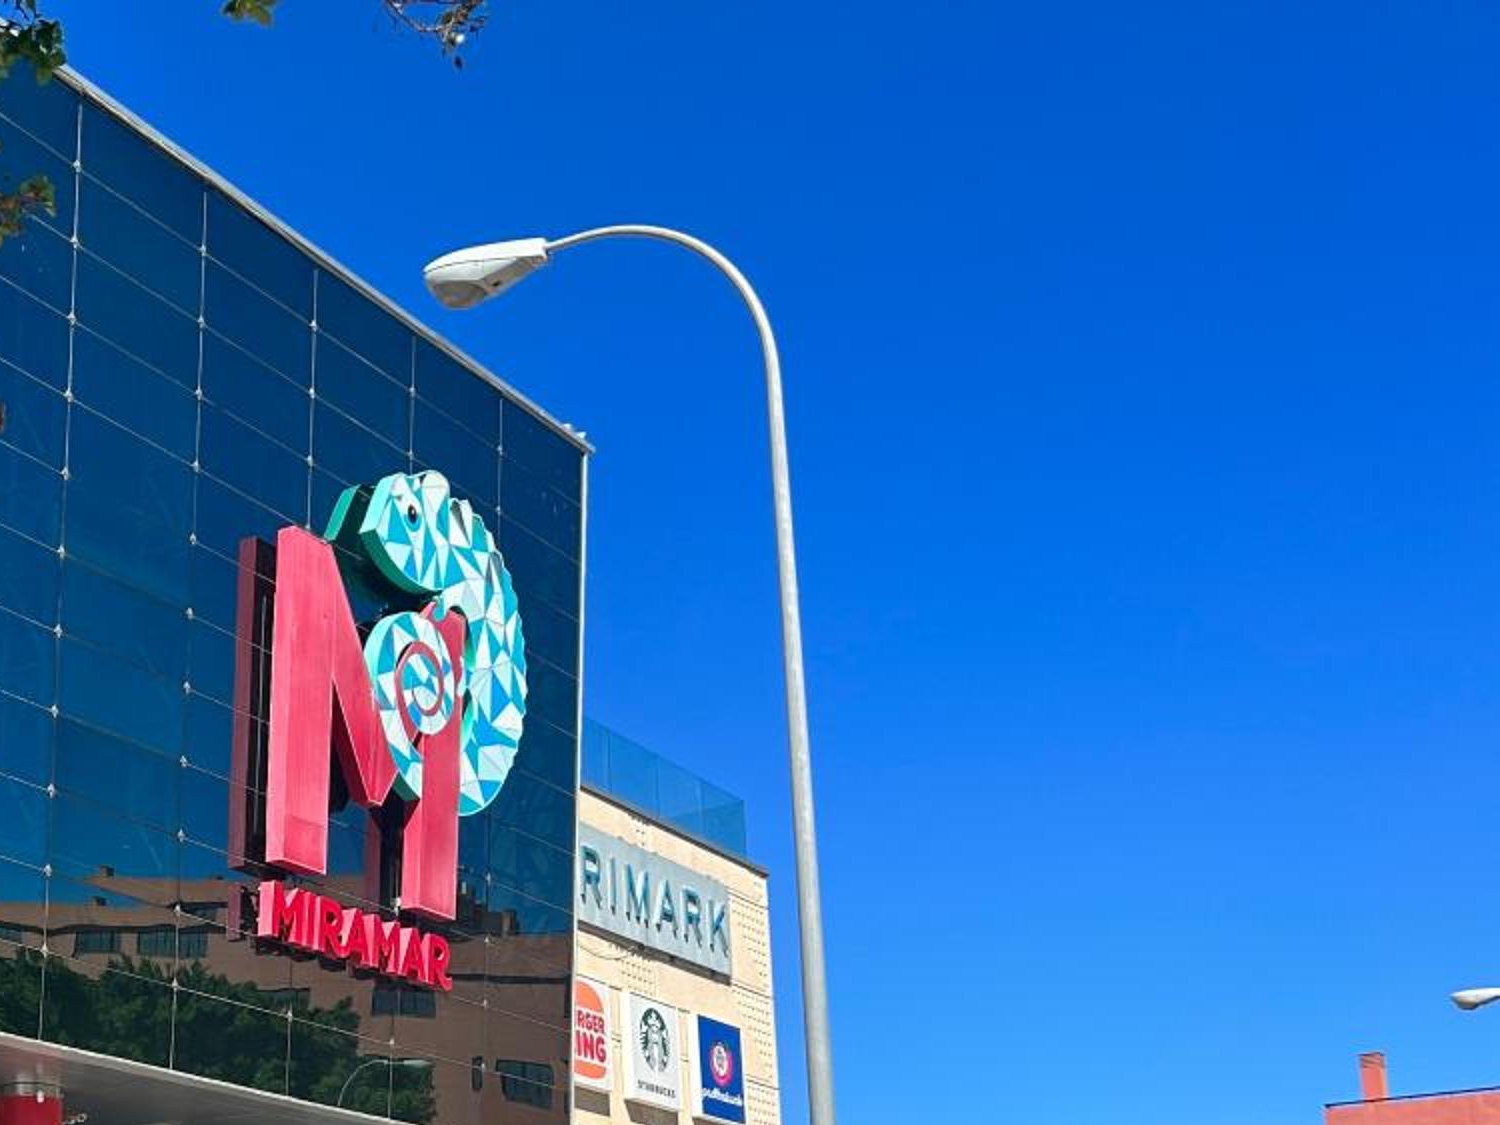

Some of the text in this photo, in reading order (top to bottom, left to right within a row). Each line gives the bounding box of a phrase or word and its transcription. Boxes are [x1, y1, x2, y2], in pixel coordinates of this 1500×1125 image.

[260, 880, 452, 990] MIRAMAR
[580, 846, 728, 955] RIMARK
[575, 1030, 607, 1063] ING
[577, 1010, 605, 1034] RGER
